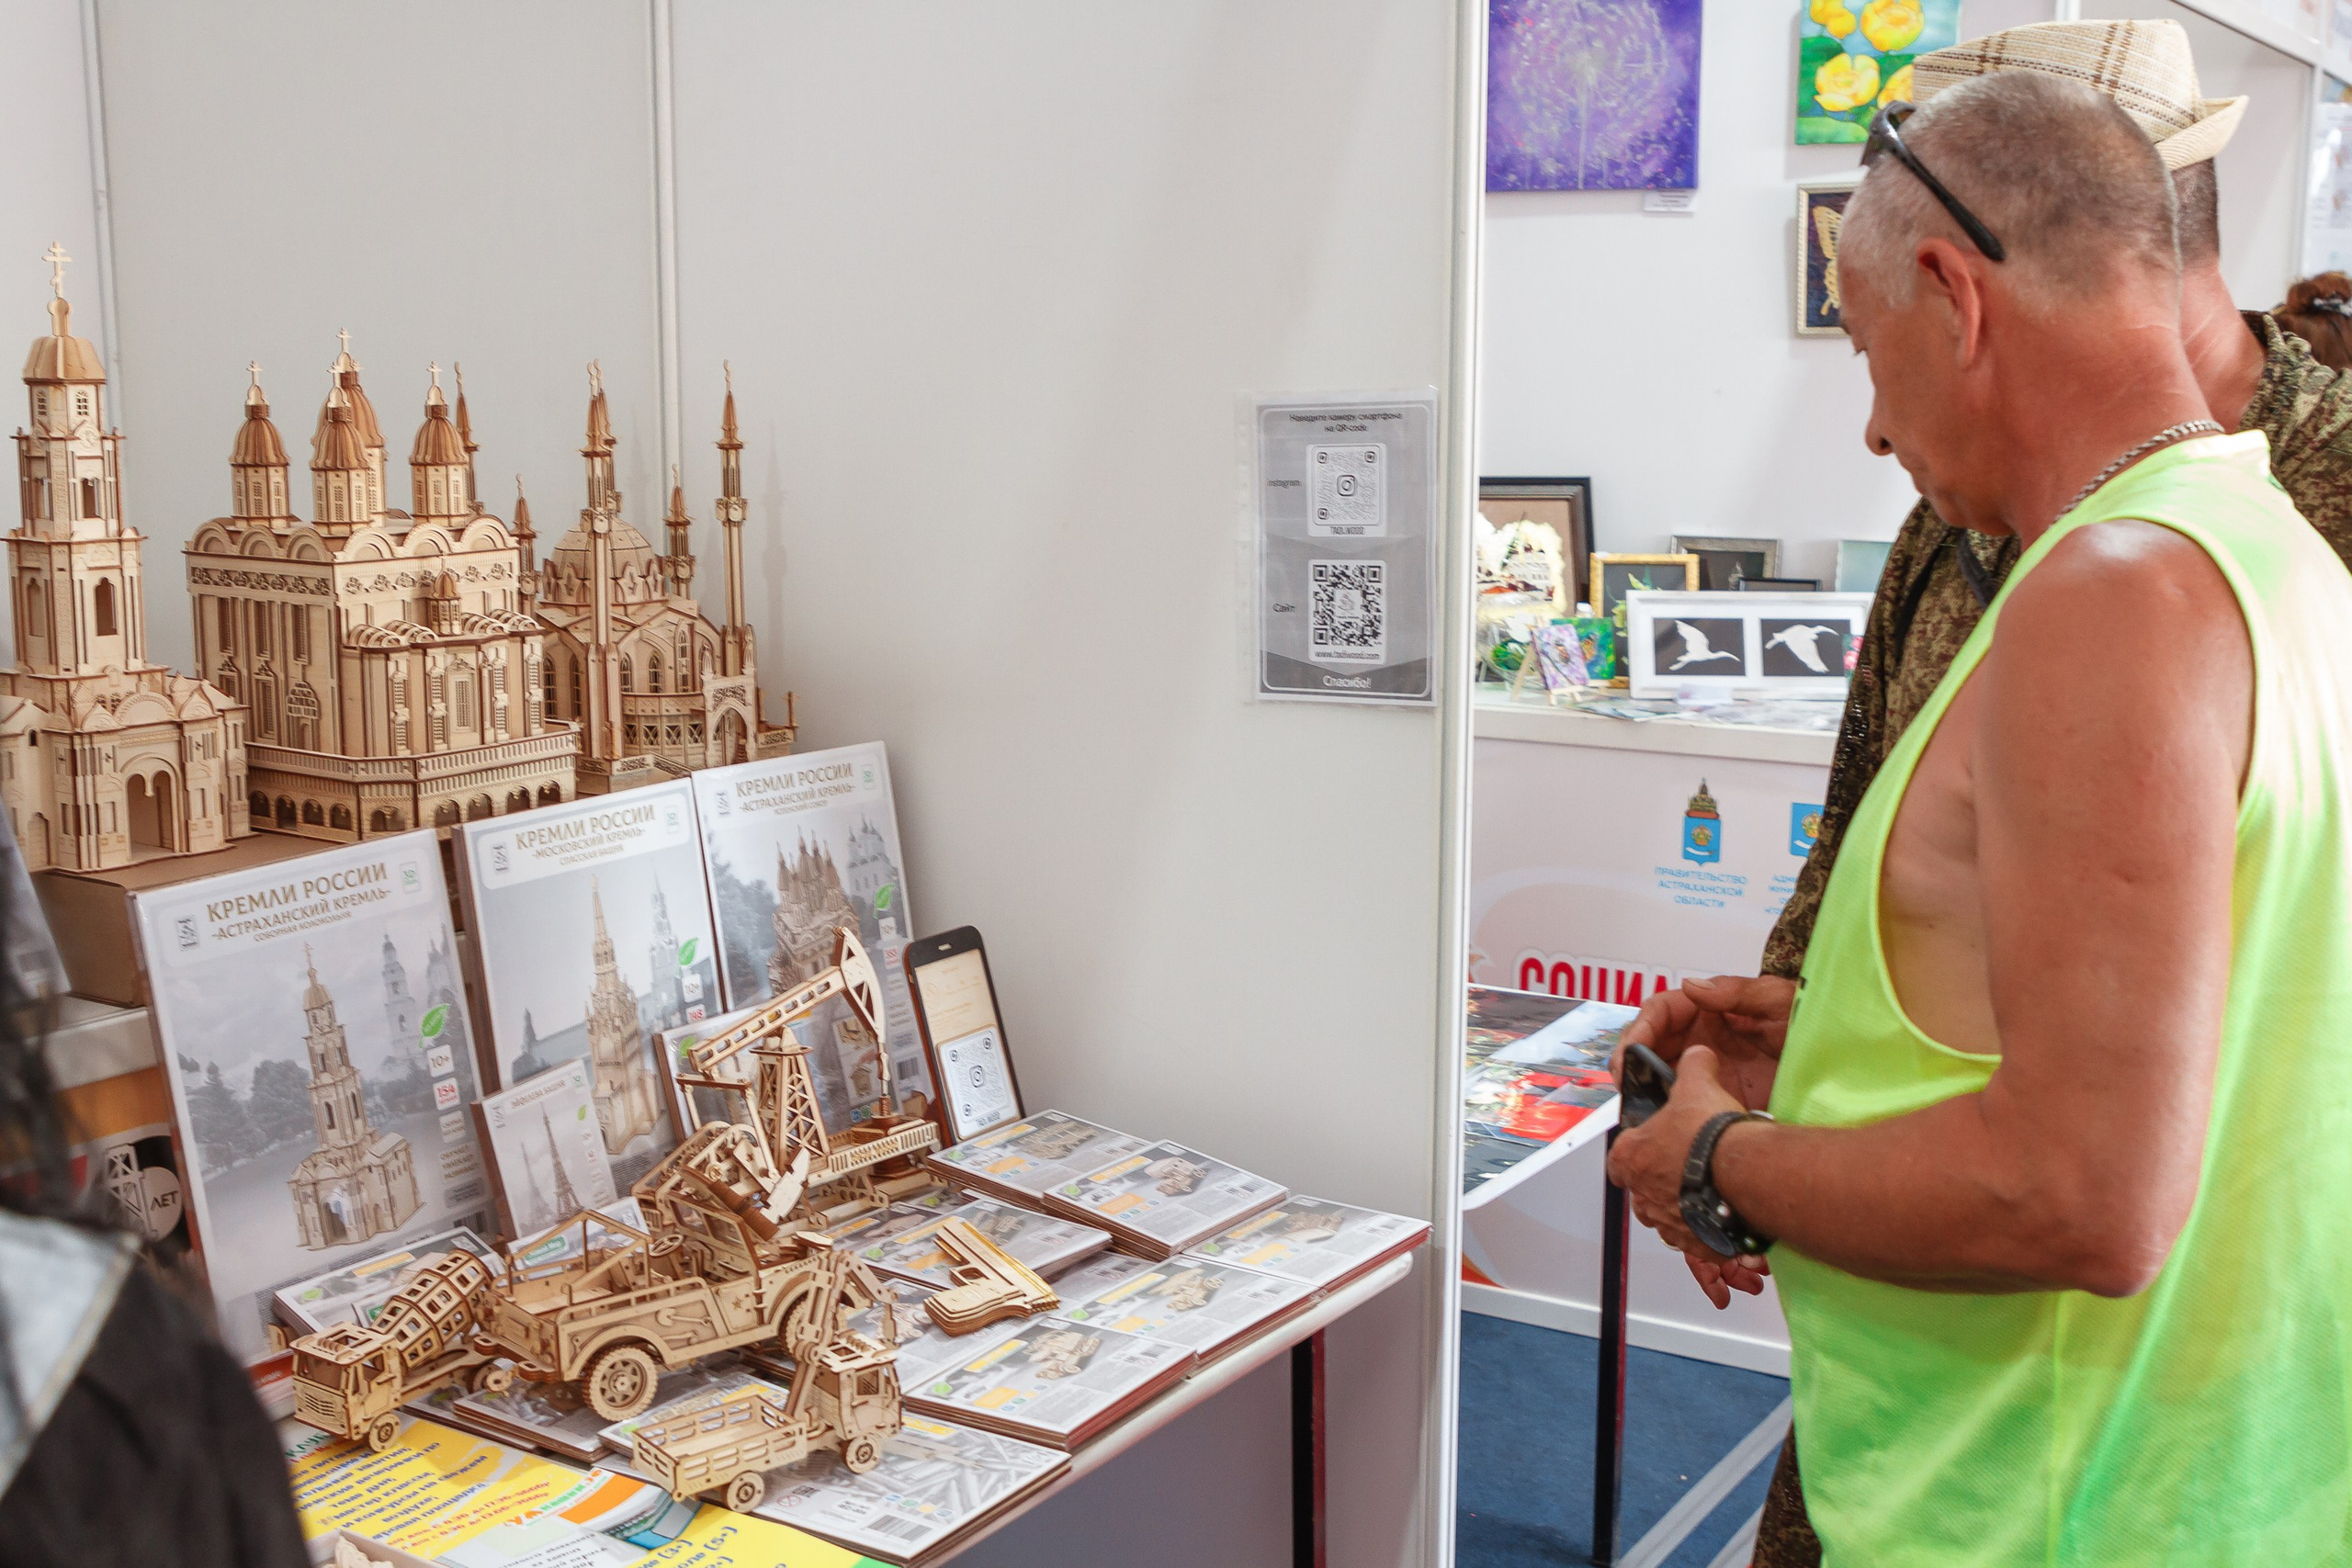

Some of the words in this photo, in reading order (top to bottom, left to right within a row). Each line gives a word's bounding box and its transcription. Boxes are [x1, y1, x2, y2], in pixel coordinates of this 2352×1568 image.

[1322, 675, 1372, 689] Спасибо!
[736, 773, 797, 796] КРЕМЛИ
[797, 762, 854, 785] РОССИИ
[514, 821, 586, 851] КРЕМЛИ
[589, 804, 656, 835] РОССИИ
[1655, 866, 1747, 886] ПРАВИТЕЛЬСТВО
[207, 884, 298, 922] КРЕМЛИ
[302, 863, 389, 898] РОССИИ
[1658, 880, 1744, 897] АСТРАХАНСКОЙ
[1674, 895, 1725, 908] ОБЛАСТИ
[150, 1190, 180, 1211] ЛЕТ
[356, 1451, 424, 1484] вечеринки
[330, 1493, 363, 1508] теме
[334, 1497, 382, 1520] мастер
[356, 1491, 418, 1523] конкурсы
[418, 1481, 437, 1492] на
[420, 1482, 488, 1517] площадка
[703, 1526, 738, 1551] (5+)
